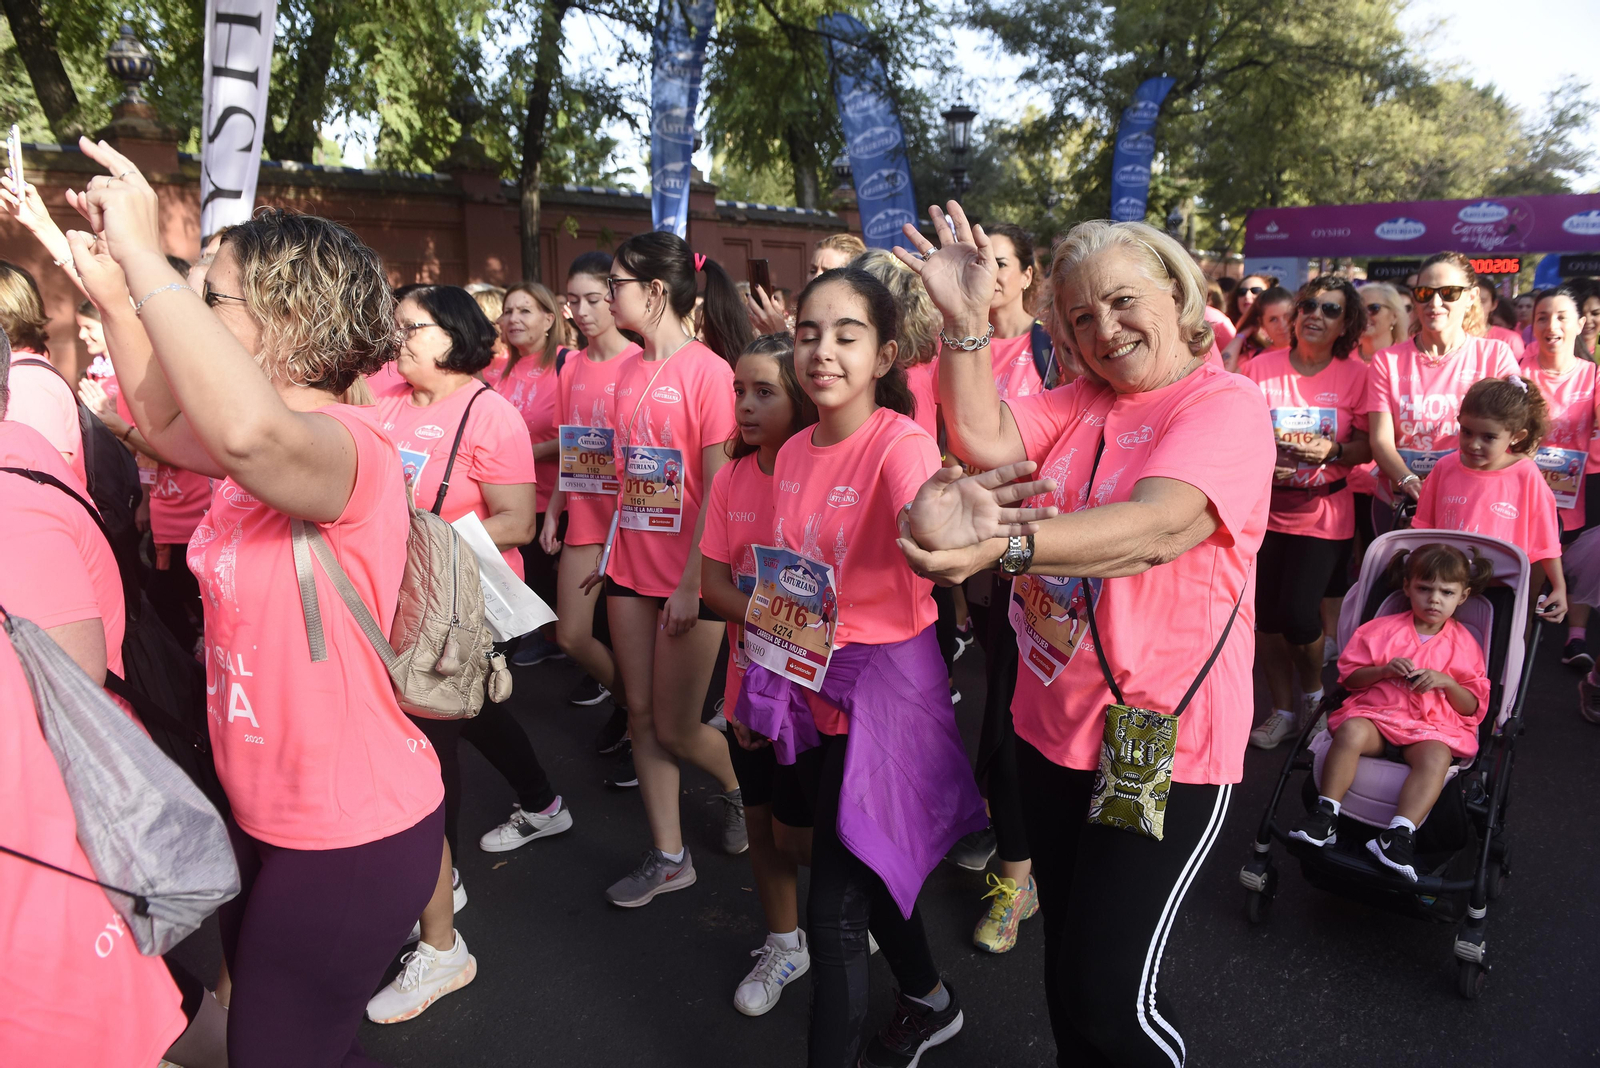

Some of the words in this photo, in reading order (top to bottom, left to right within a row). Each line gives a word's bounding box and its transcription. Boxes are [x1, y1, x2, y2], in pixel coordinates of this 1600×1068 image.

[1311, 227, 1351, 238] OYSHO
[580, 438, 606, 446] ASTURIANA
[1283, 432, 1313, 444] 016
[1400, 435, 1433, 451] LAS
[579, 452, 606, 466] 016
[565, 481, 587, 489] OYSHO
[626, 479, 656, 495] 016
[728, 511, 756, 522] YSHO
[1493, 505, 1517, 518] ASTURIANA
[781, 571, 816, 594] ASTURIANA
[770, 595, 809, 627] 016
[772, 623, 793, 640] 4274
[745, 639, 766, 657] OYSHO
[756, 628, 774, 643] CARRERA
[773, 637, 781, 646] DE
[781, 640, 788, 649] LA
[789, 643, 808, 658] MUJER
[1033, 632, 1049, 651] MUJER
[793, 665, 812, 676] Santander
[244, 733, 265, 745] 2022
[406, 735, 433, 753] OY
[94, 913, 126, 959] OY
